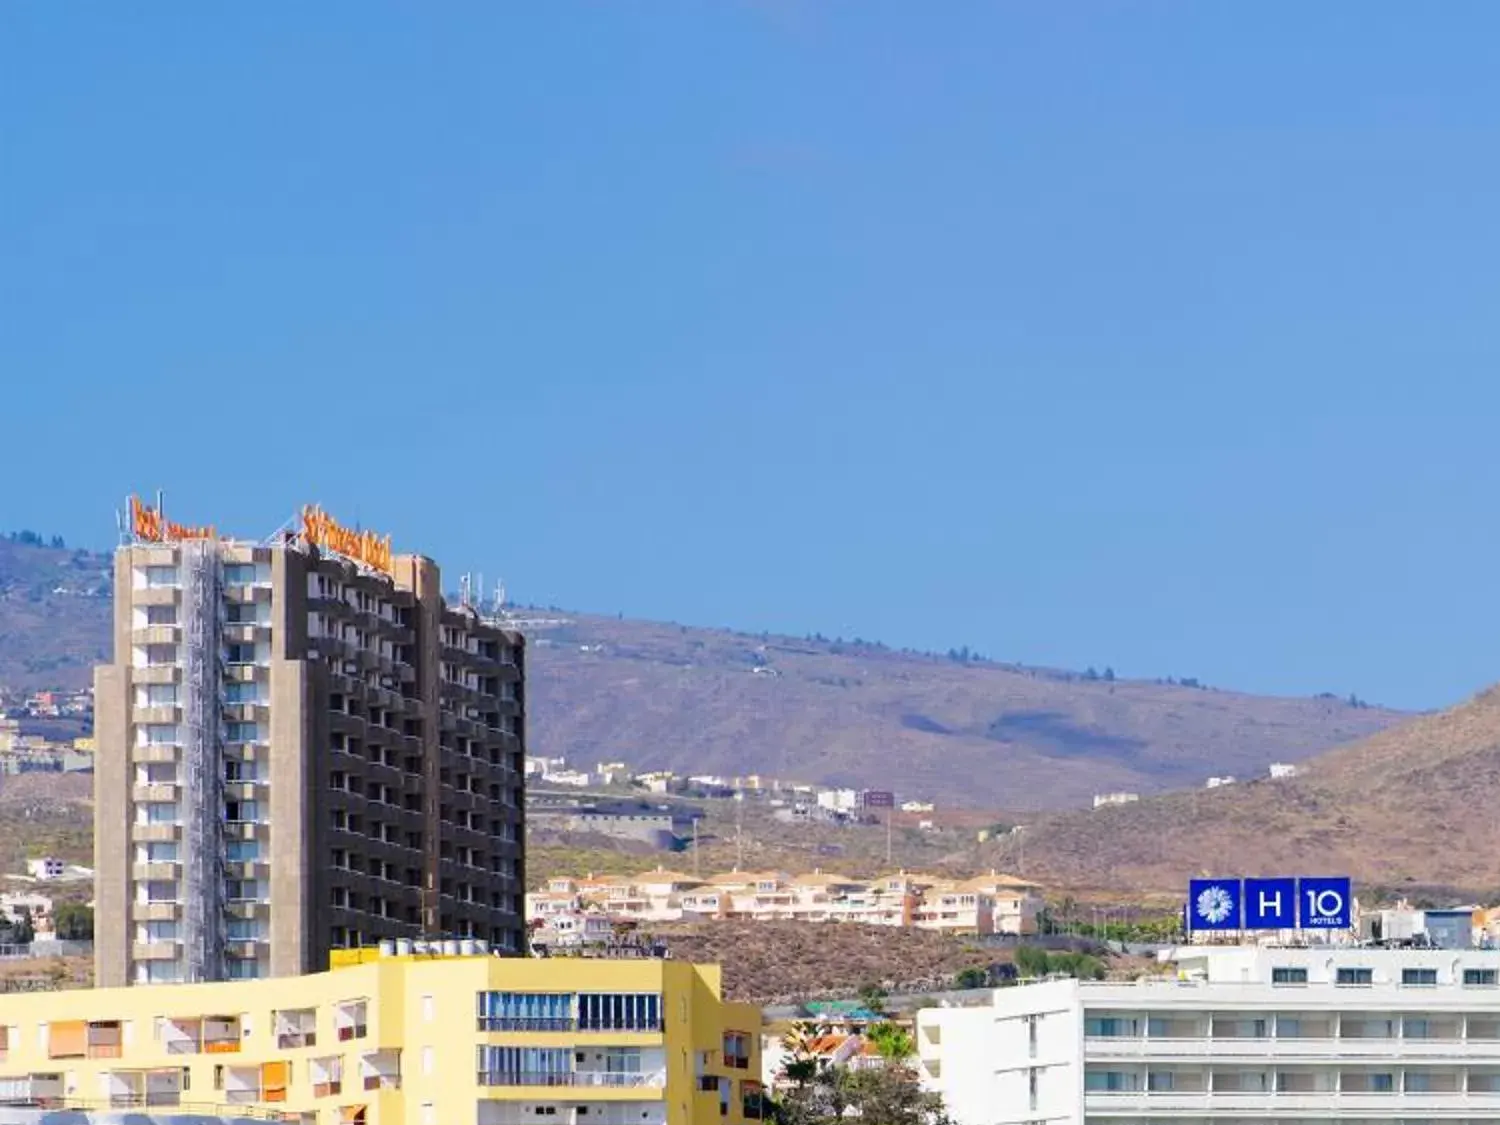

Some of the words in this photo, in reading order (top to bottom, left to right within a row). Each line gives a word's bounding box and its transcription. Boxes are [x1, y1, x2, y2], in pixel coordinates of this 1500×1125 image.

[1259, 891, 1281, 917] H
[1306, 890, 1343, 917] 10
[1309, 917, 1343, 925] HOTELS
